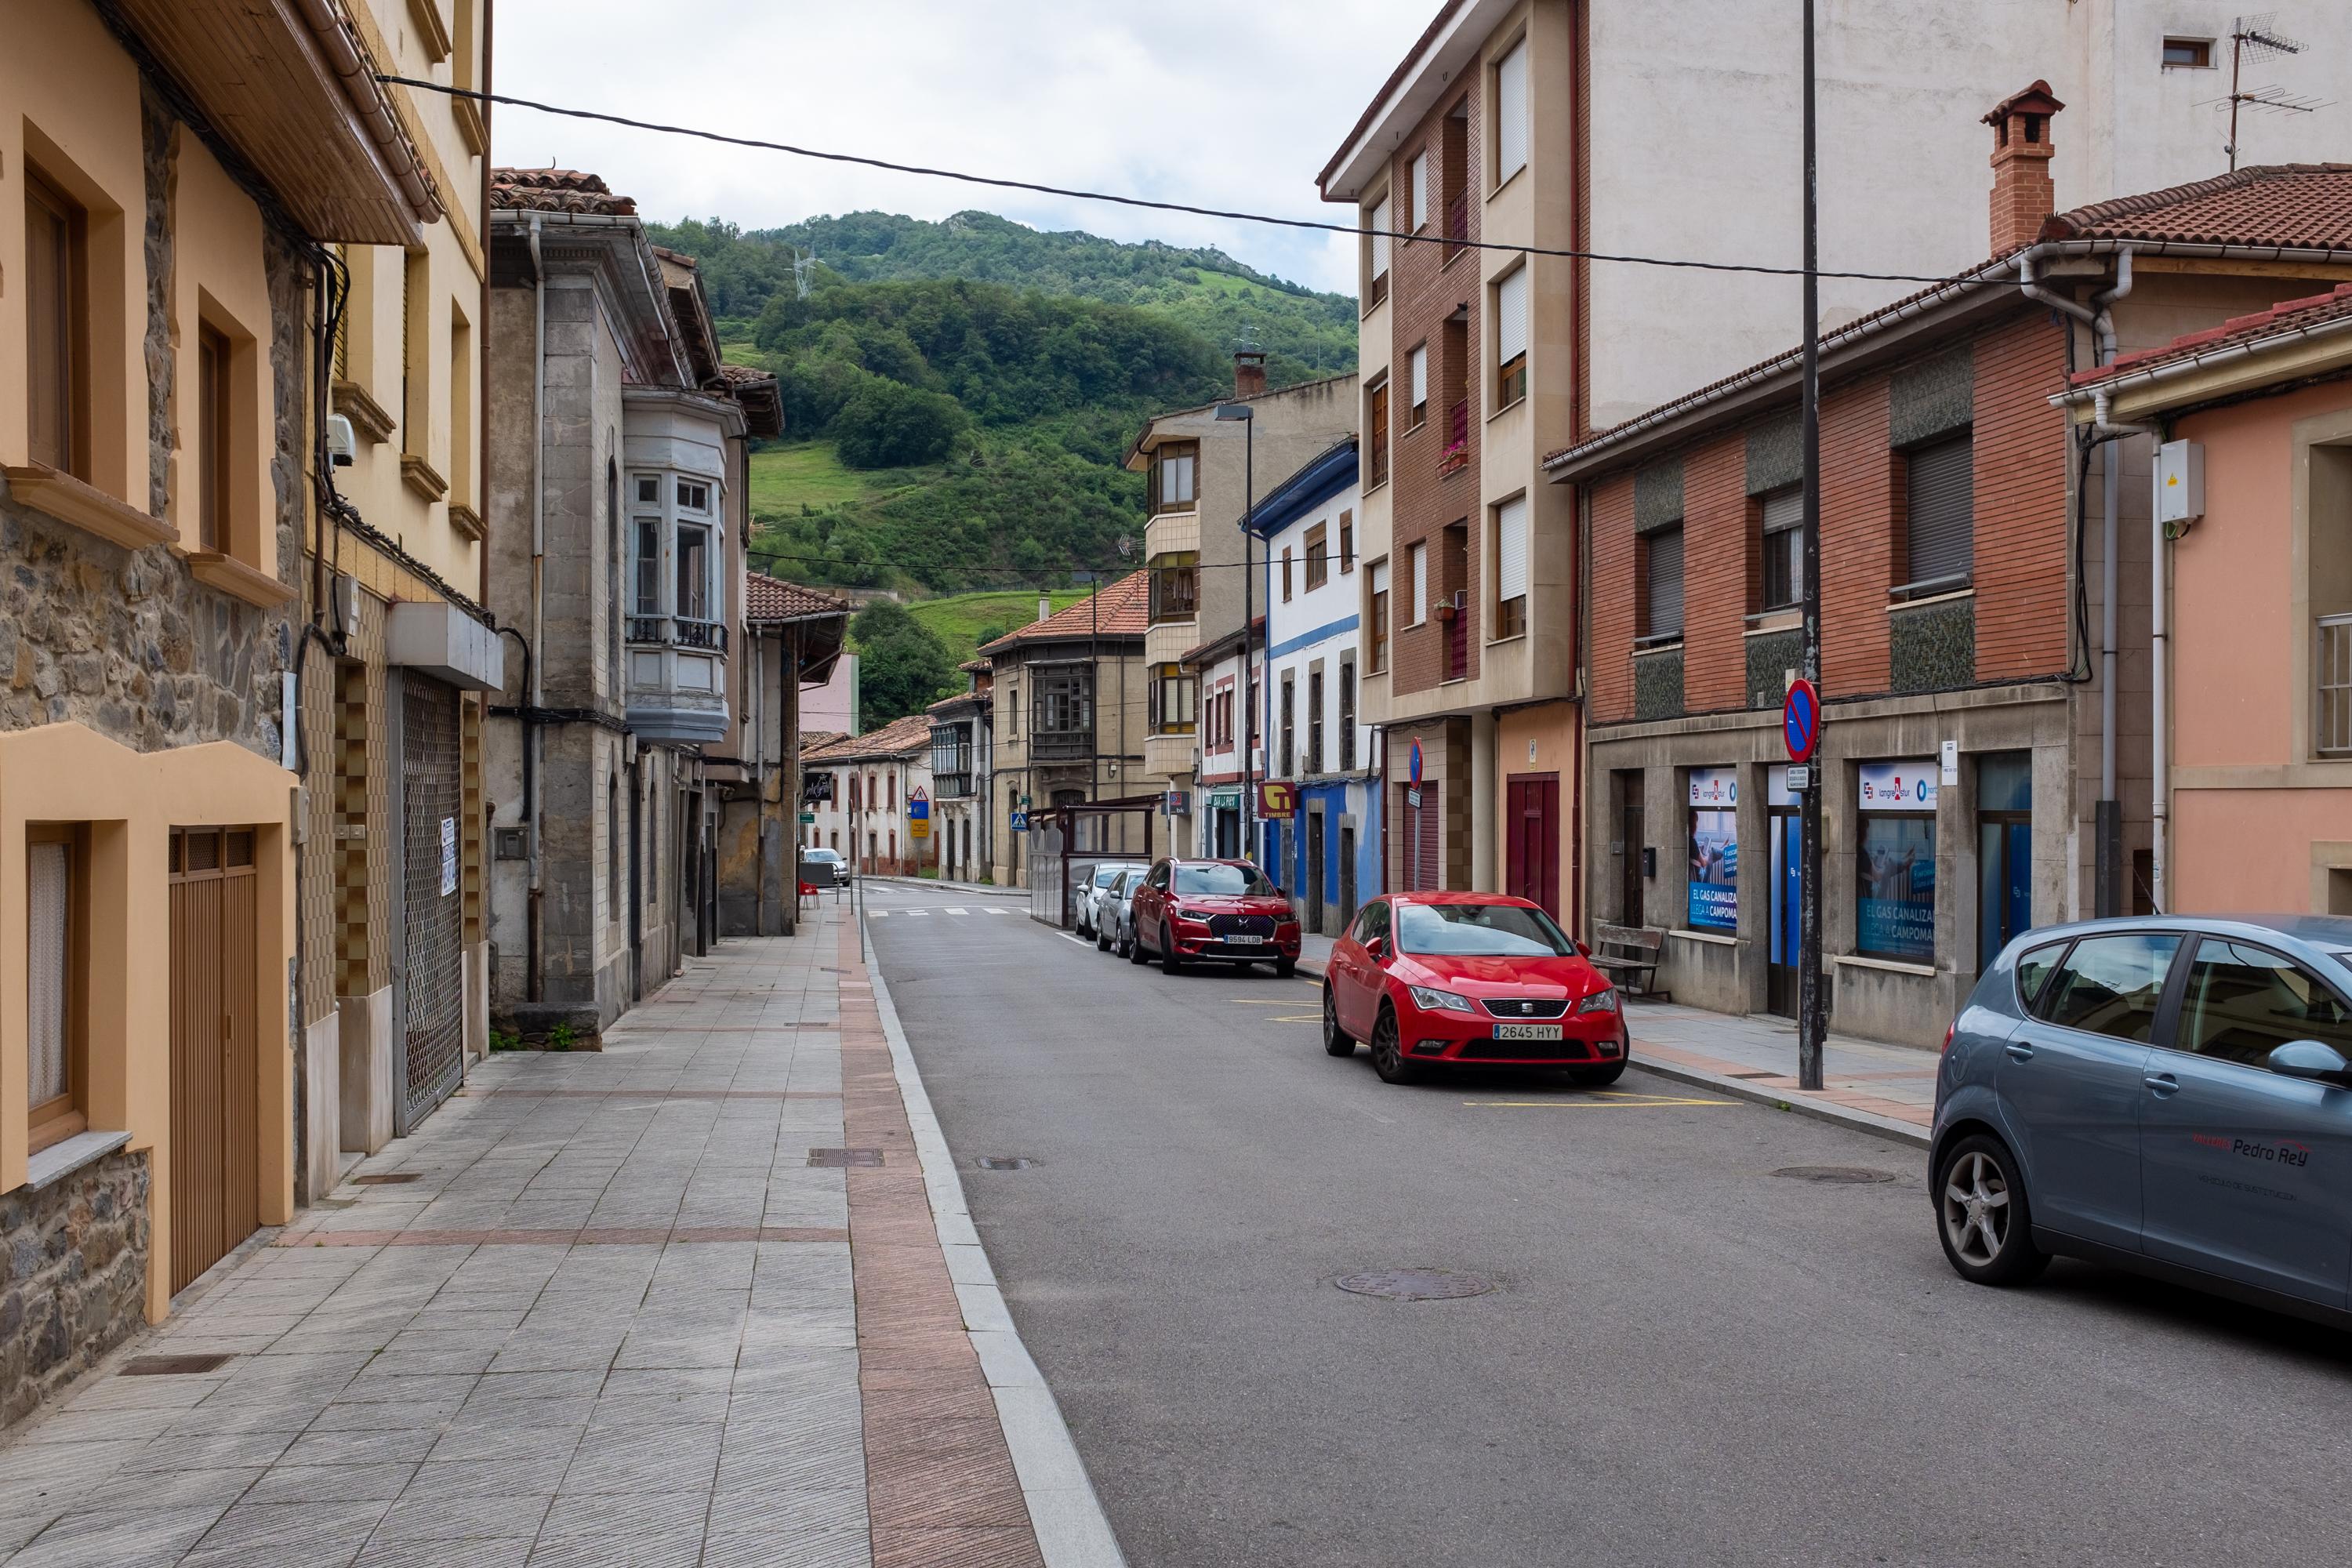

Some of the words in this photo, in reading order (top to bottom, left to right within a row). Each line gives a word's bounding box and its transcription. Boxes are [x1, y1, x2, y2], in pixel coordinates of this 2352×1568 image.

[1693, 889, 1699, 900] EL
[1700, 890, 1710, 902] GAS
[1711, 891, 1737, 904] CANALIZA
[1710, 906, 1737, 919] CAMPOMA
[1867, 905, 1876, 917] EL
[1876, 906, 1892, 919] GAS
[1893, 906, 1935, 924] CANALIZA
[1891, 925, 1935, 942] CAMPOMA
[1502, 1026, 1533, 1038] 2645
[1537, 1026, 1559, 1039] HYY
[2233, 1139, 2274, 1160] Pedro
